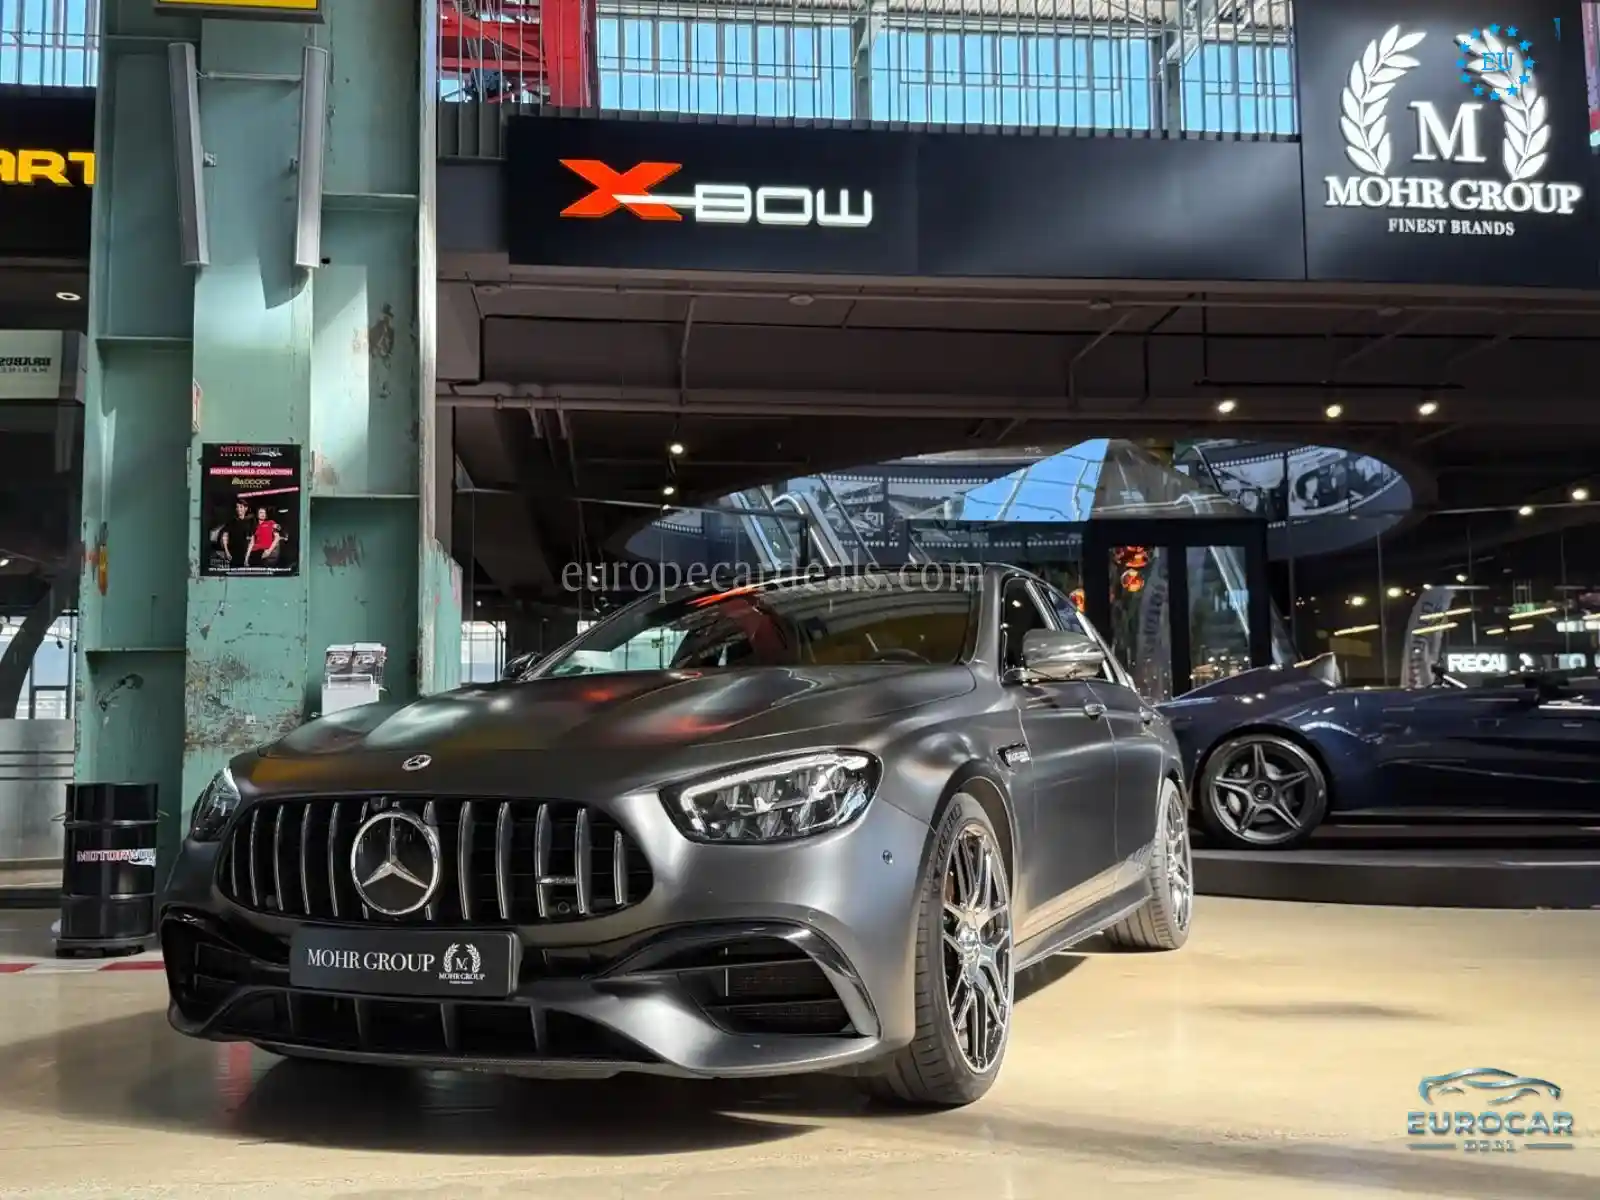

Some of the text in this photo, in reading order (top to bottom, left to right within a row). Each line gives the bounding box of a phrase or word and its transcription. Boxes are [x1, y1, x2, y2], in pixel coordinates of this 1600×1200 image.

[1409, 100, 1487, 163] M
[1324, 175, 1583, 215] MOHR GROUP
[1387, 217, 1516, 237] FINEST BRANDS
[308, 948, 436, 972] MOHR GROUP
